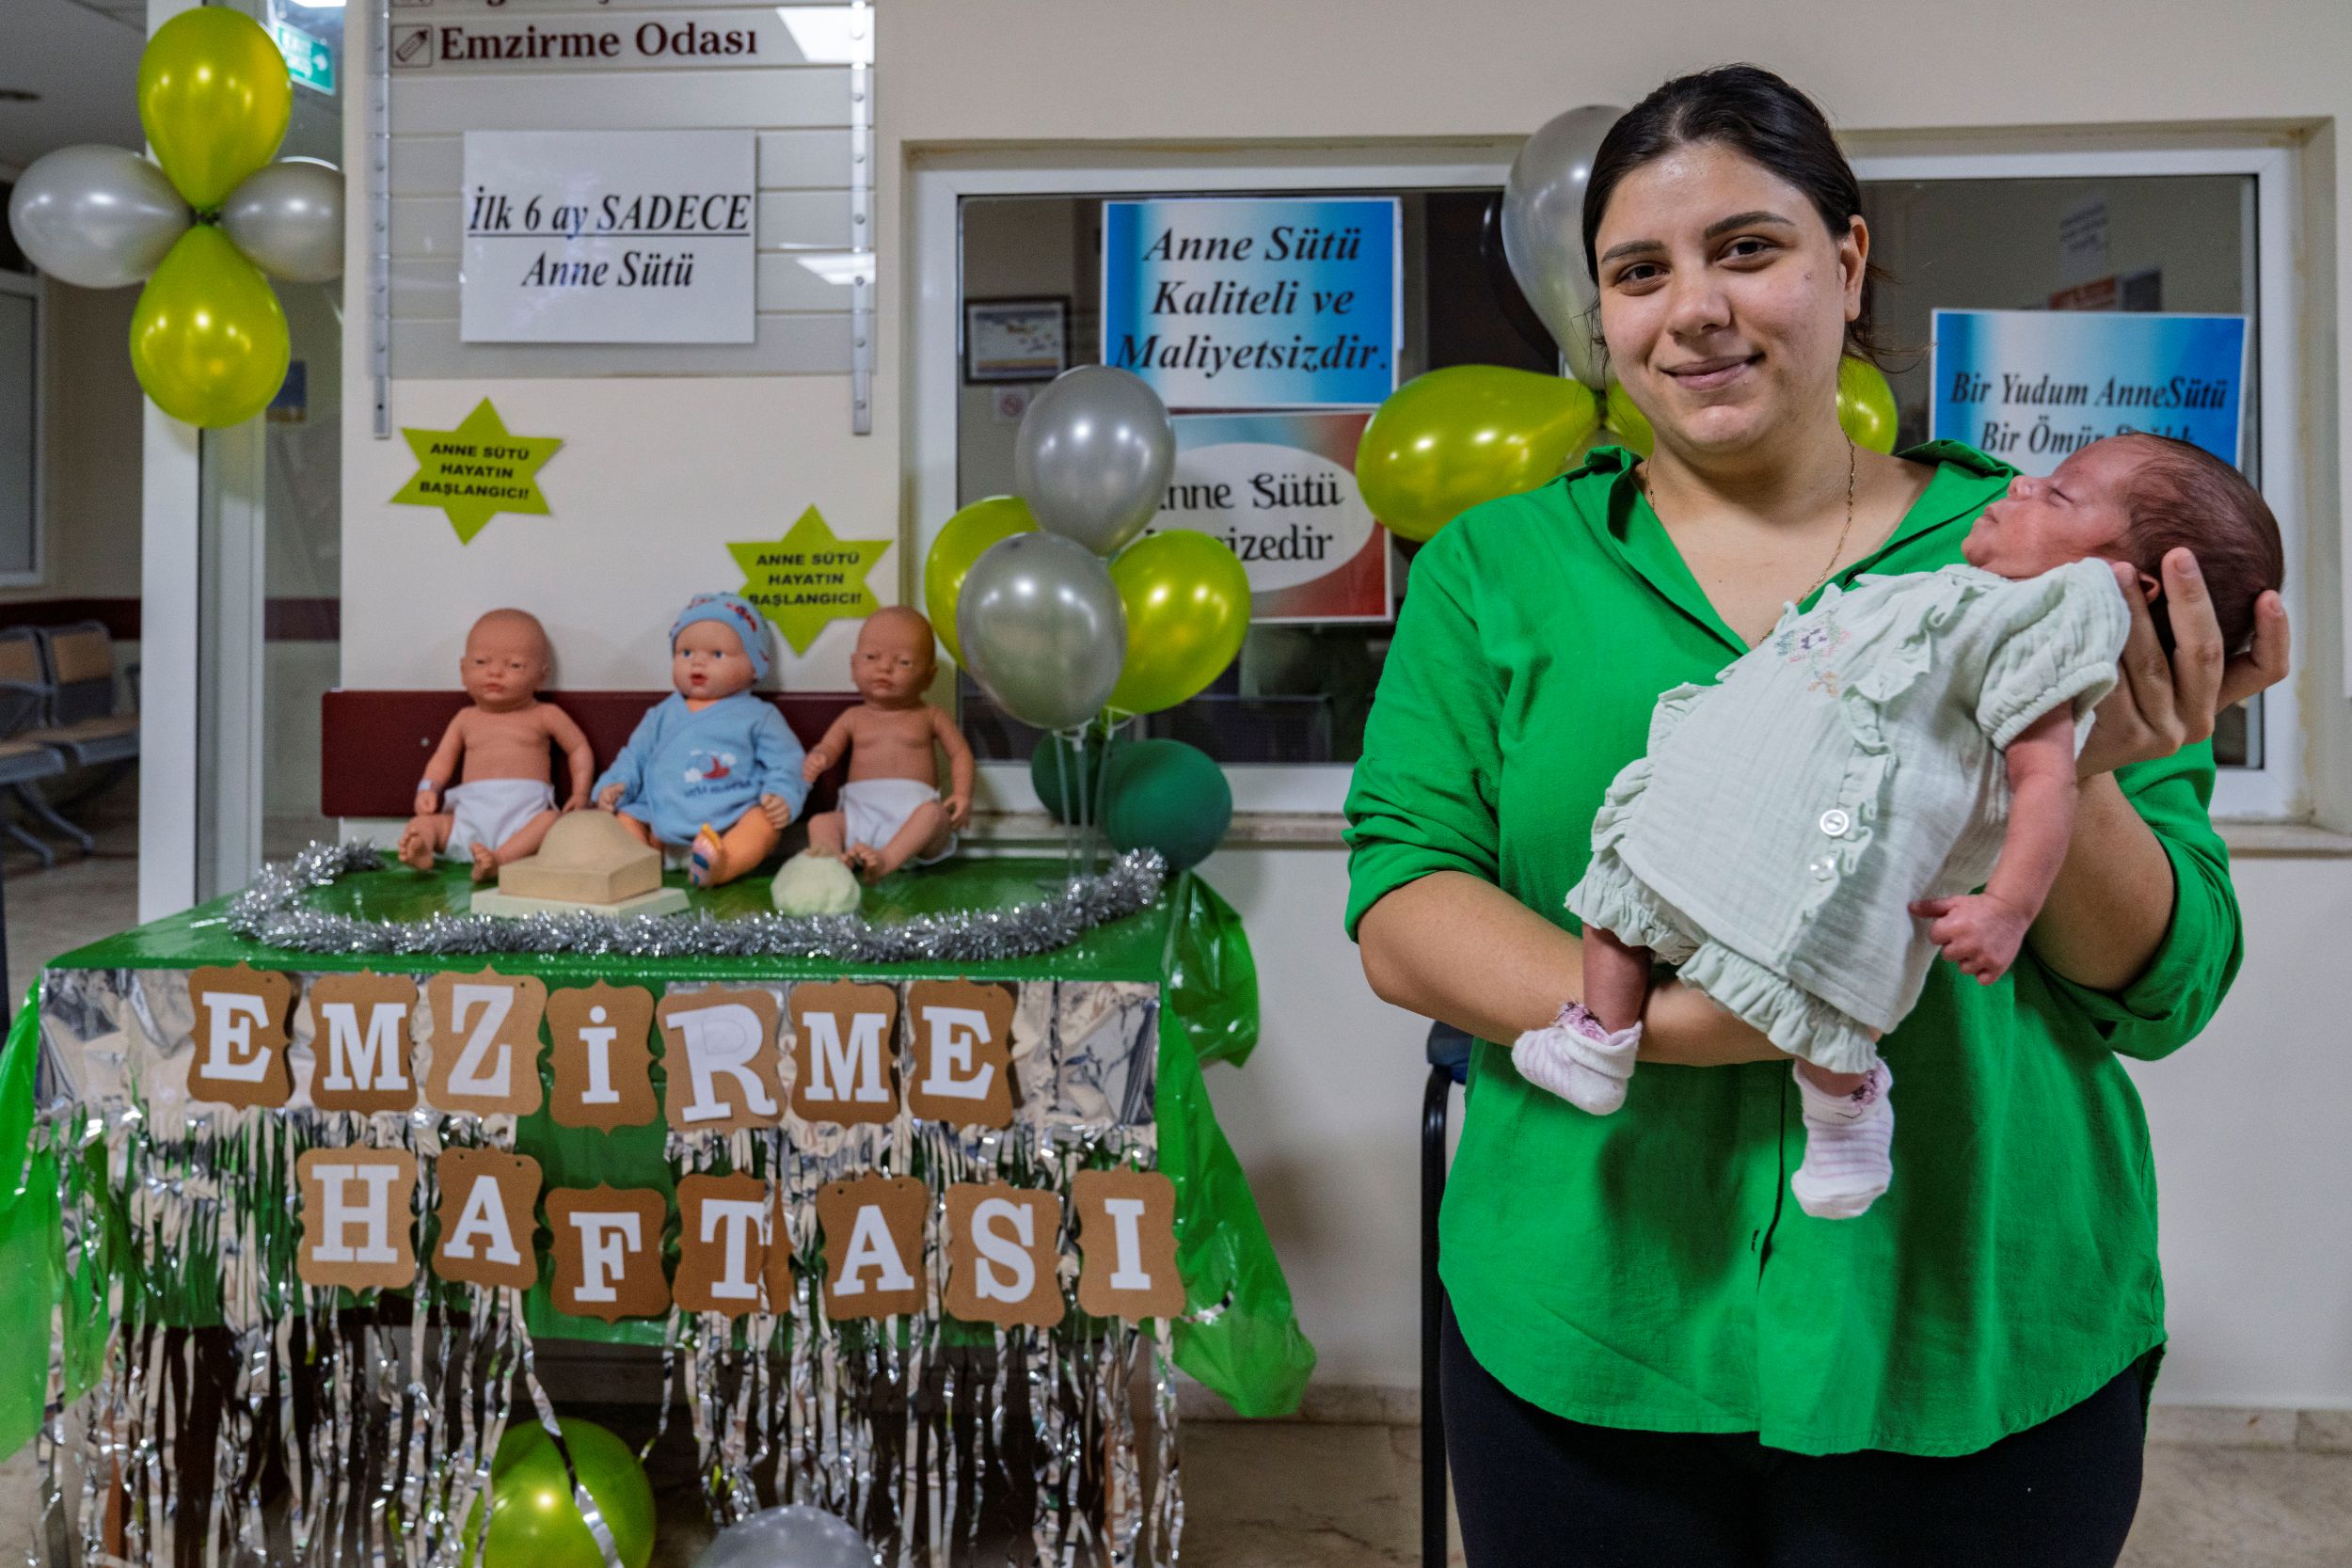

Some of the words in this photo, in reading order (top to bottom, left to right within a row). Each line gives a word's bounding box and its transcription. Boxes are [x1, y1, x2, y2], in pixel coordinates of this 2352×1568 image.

[440, 25, 620, 61] Emzirme
[636, 23, 758, 55] Odası
[468, 186, 514, 231] İlk
[524, 194, 544, 231] 6
[551, 205, 589, 240] ay
[596, 193, 752, 231] SADECE
[1143, 227, 1254, 262] Anne
[1264, 226, 1361, 262] Sütü
[521, 251, 610, 287] Anne
[617, 251, 694, 287] Sütü
[1152, 280, 1300, 316] Kaliteli
[1311, 289, 1356, 316] ve
[1115, 334, 1387, 378] Maliyetsizdir.
[1950, 372, 1992, 404] Bir
[2001, 372, 2089, 407] Yudum
[2094, 374, 2228, 409] AnneSütü
[430, 442, 477, 458] ANNE
[483, 446, 531, 461] SÜTÜ
[1980, 421, 2020, 453] Bir
[440, 464, 514, 480] HAYATIN
[420, 482, 530, 500] BAŞLANGICI!
[1160, 483, 1234, 510] nne
[1248, 472, 1345, 510] Sütü
[755, 553, 805, 566] ANNE
[812, 551, 860, 566] SÜTÜ
[1145, 523, 1334, 562] izedir
[768, 573, 845, 586] HAYATIN
[748, 593, 862, 608] BAŞLANGICI!
[312, 1164, 1152, 1304] HAFTASI
